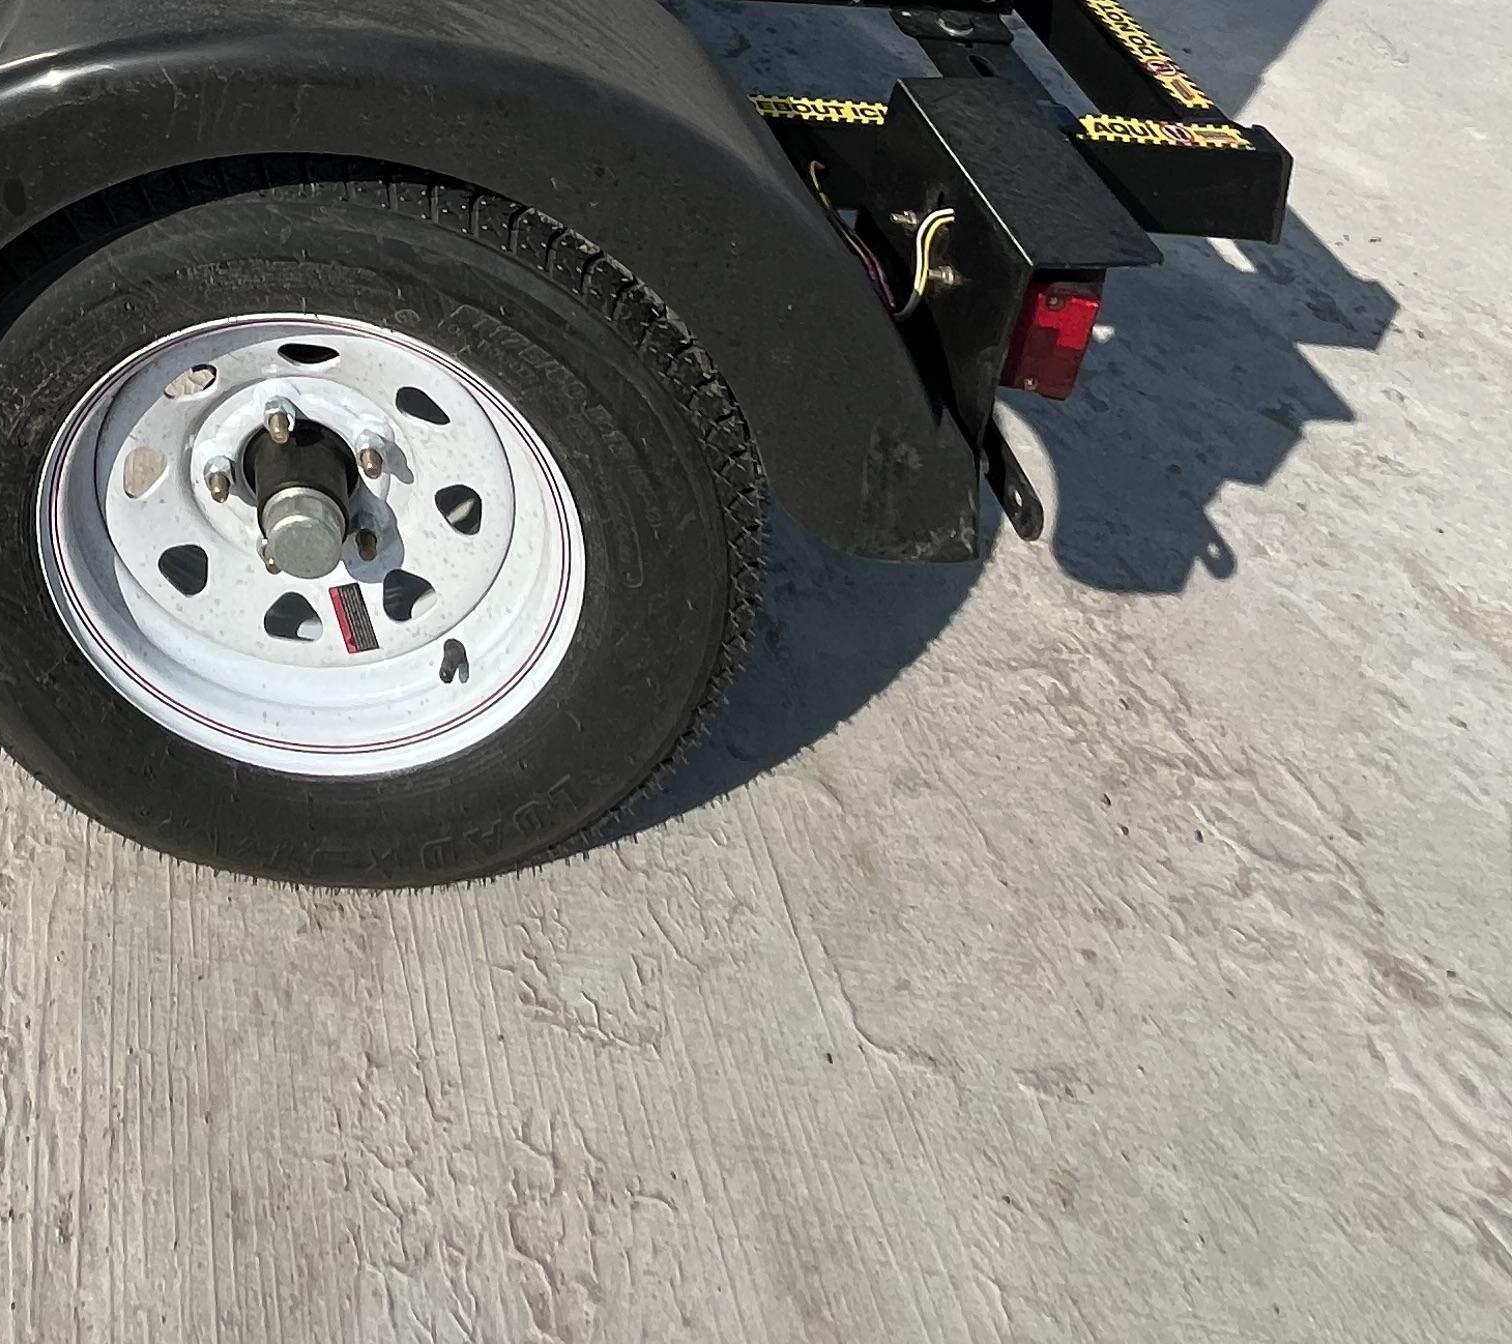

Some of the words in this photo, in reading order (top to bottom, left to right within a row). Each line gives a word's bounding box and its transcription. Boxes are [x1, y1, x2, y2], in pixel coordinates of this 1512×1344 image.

[1098, 3, 1137, 35] NOT
[1129, 35, 1158, 57] DO
[1094, 121, 1158, 138] AQUI
